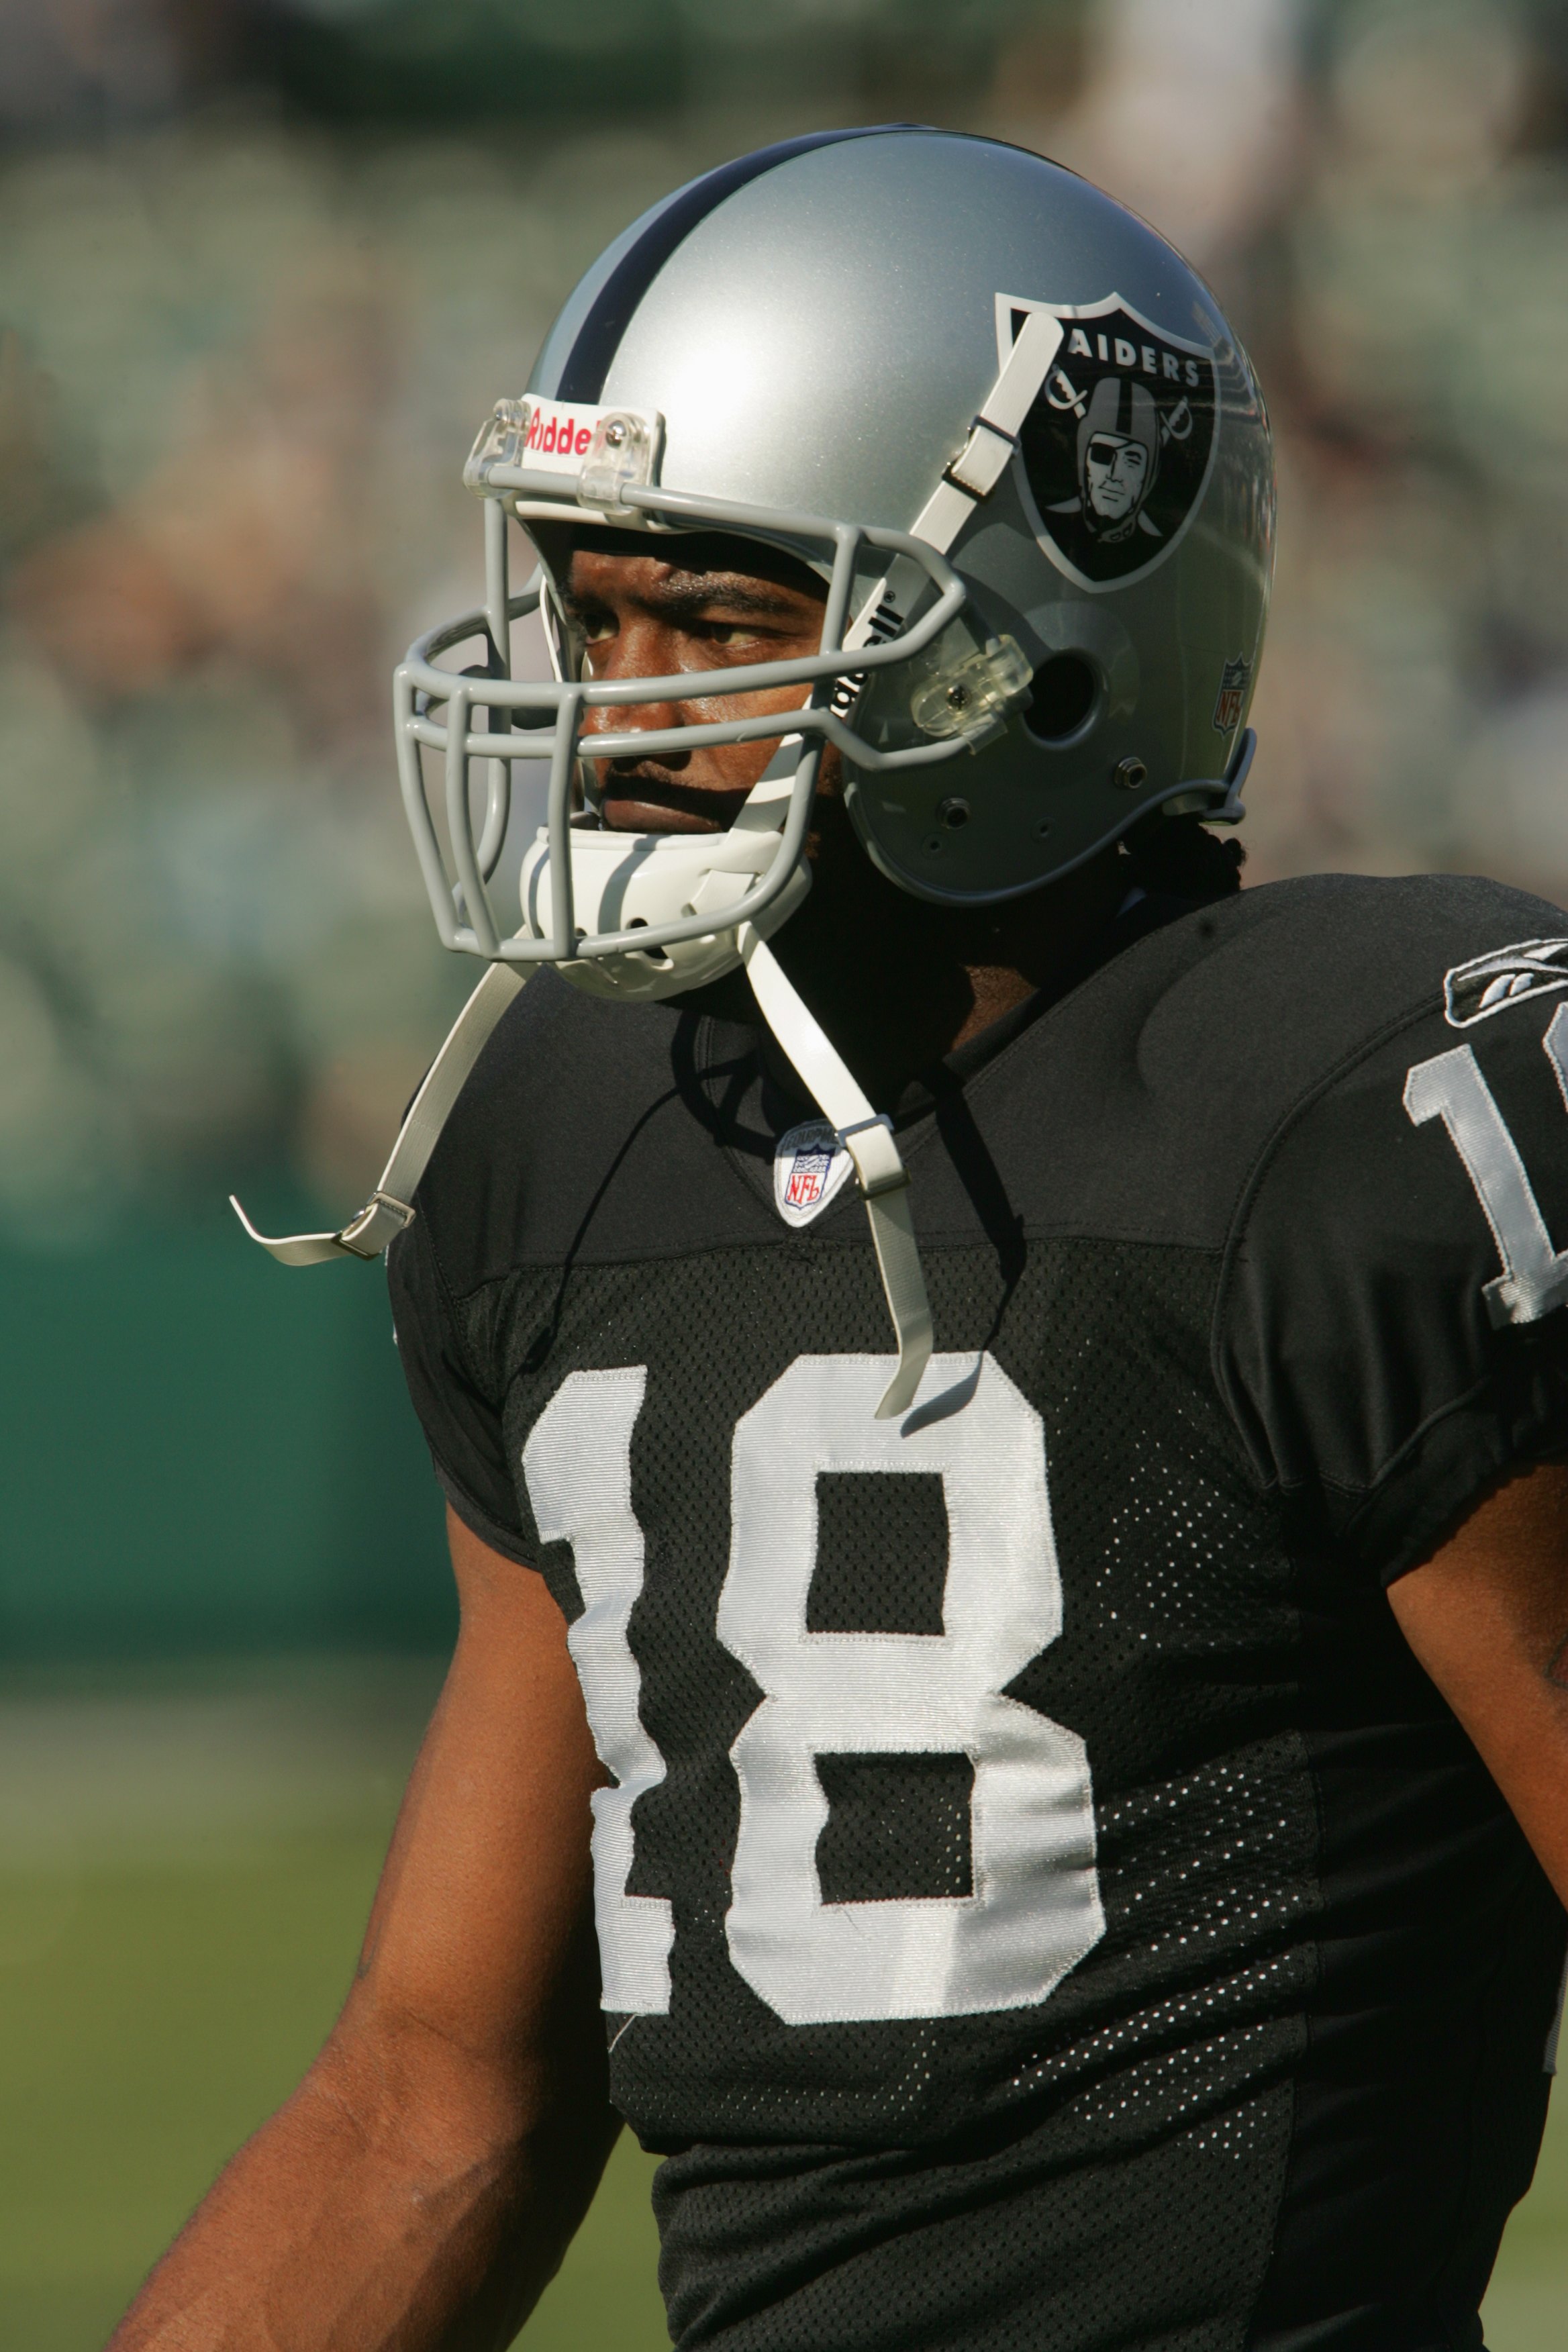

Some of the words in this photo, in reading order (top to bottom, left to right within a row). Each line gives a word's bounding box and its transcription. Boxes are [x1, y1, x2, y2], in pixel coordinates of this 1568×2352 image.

[1067, 328, 1199, 387] AIDERS
[788, 1175, 820, 1205] NFL
[522, 1351, 1106, 2025] 18
